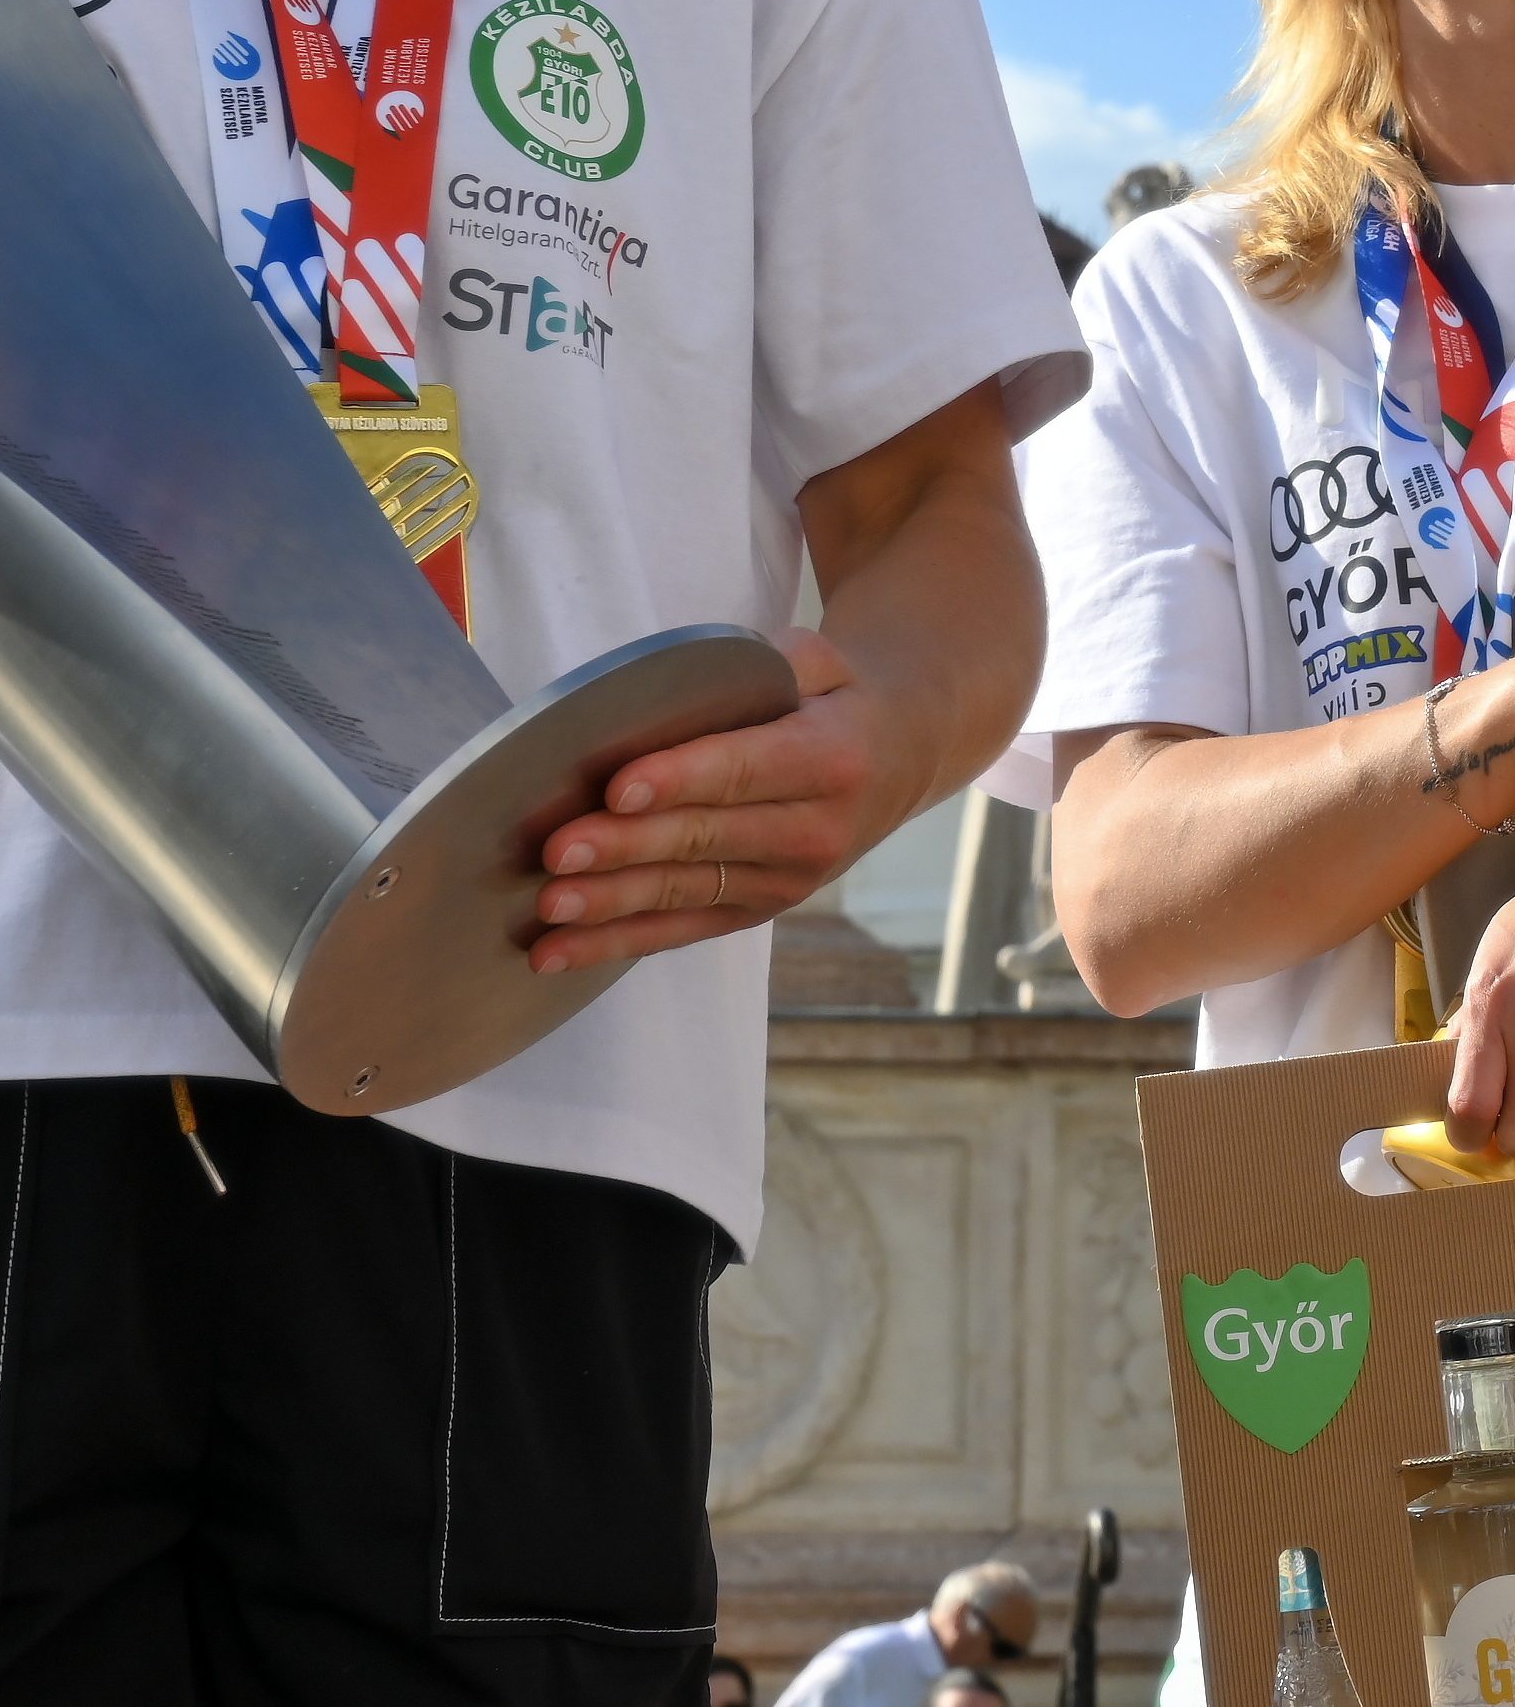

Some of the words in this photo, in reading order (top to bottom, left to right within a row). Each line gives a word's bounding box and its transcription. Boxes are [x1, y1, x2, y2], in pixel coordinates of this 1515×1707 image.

[536, 46, 563, 59] 1904
[251, 85, 269, 125] MAGYAR
[540, 73, 591, 125] ETO
[523, 140, 602, 179] CLUB
[1203, 1300, 1354, 1372] Győr
